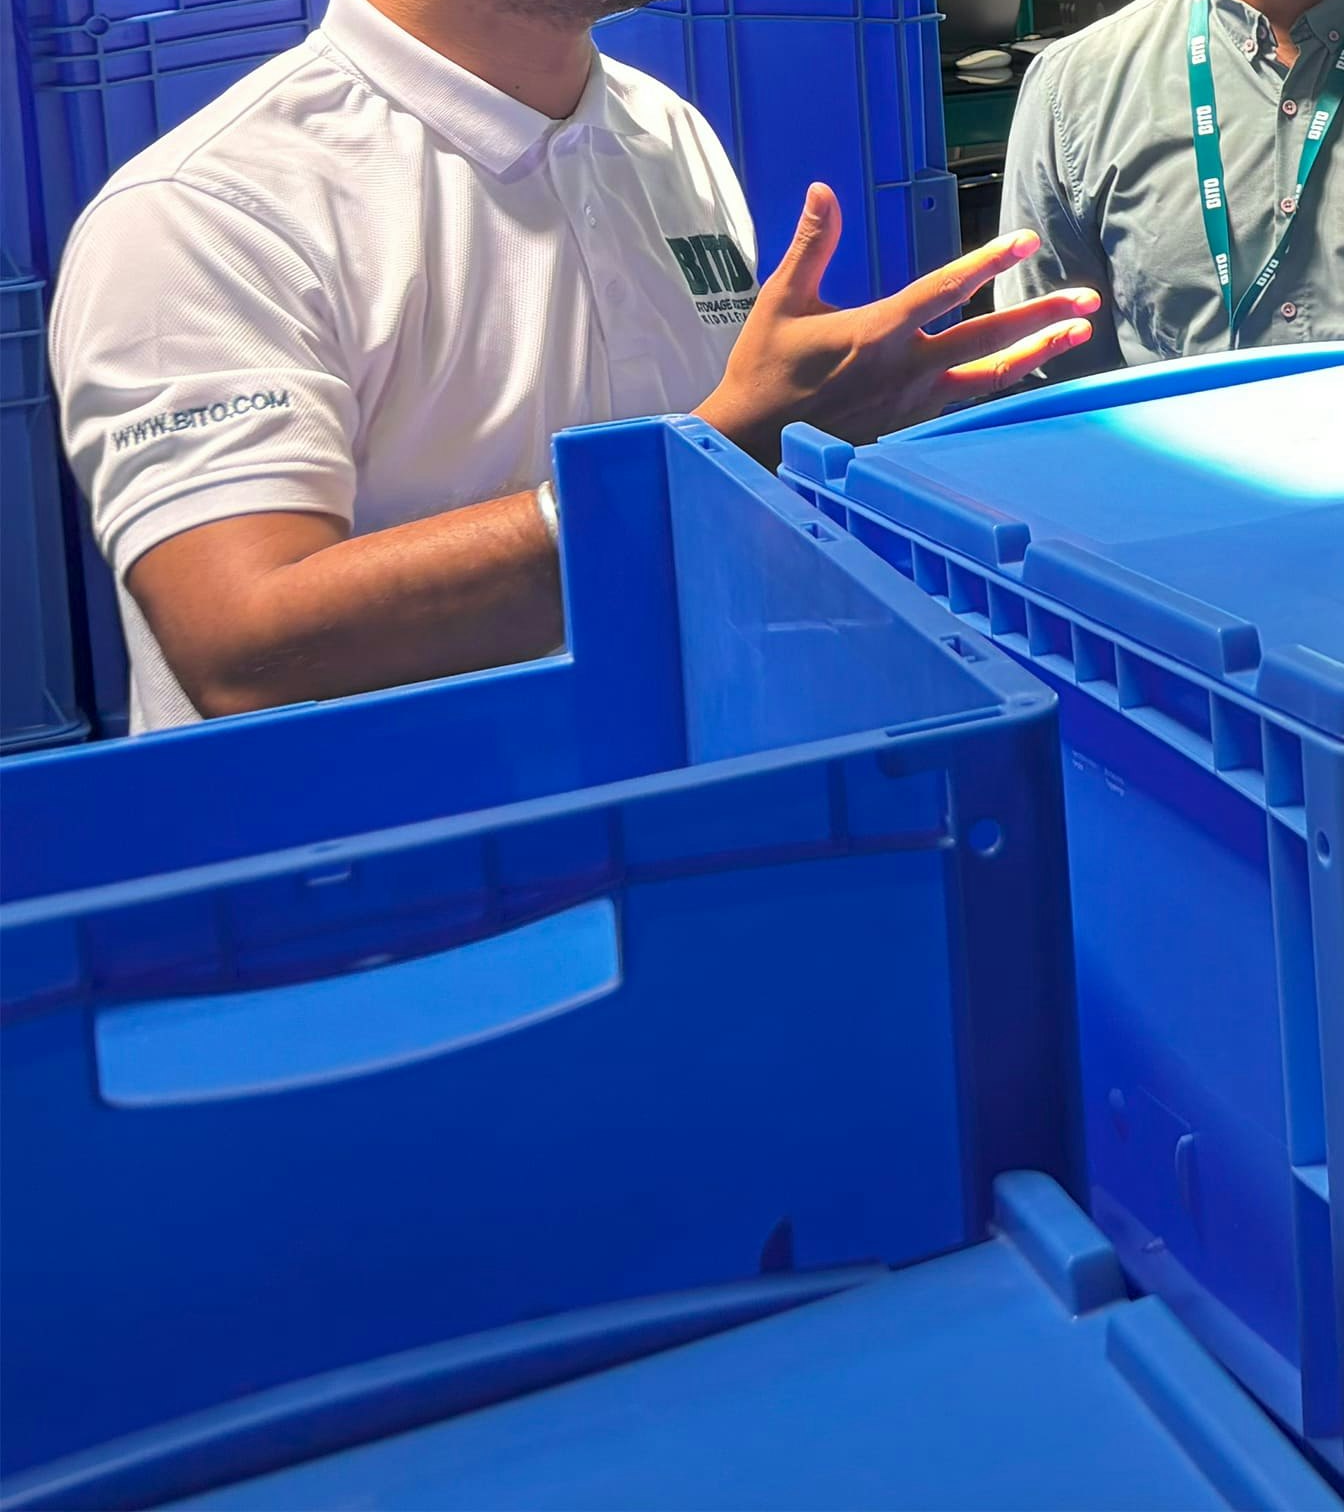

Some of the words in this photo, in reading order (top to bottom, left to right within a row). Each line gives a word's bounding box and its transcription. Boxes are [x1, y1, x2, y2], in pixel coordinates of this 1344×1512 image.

[1195, 104, 1215, 137] BITO
[1307, 110, 1330, 141] BITO
[1202, 177, 1223, 210] BITO
[665, 234, 754, 296] BITO
[112, 389, 291, 452] WWW.BITO.COM
